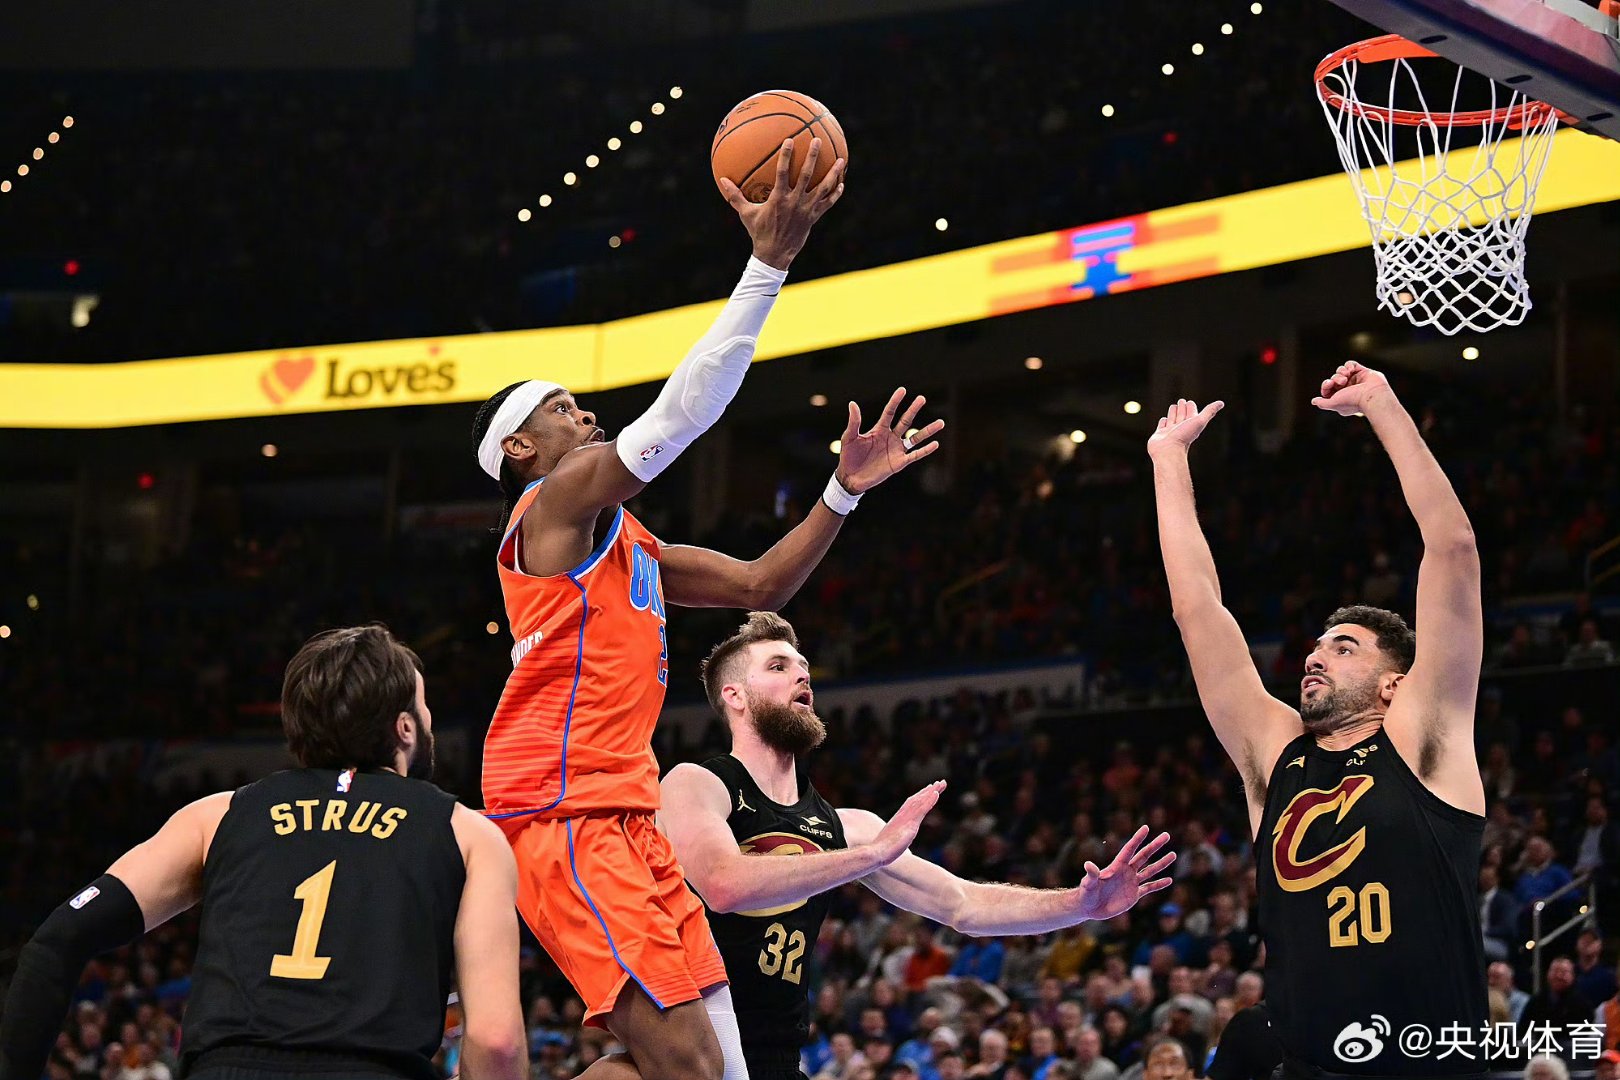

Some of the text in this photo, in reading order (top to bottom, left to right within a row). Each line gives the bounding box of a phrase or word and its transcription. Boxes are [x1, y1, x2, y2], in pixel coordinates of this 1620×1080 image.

[269, 799, 408, 840] STRUS
[799, 824, 833, 839] CLIFFS
[269, 859, 337, 980] 1
[1326, 881, 1392, 948] 20
[758, 922, 806, 985] 32
